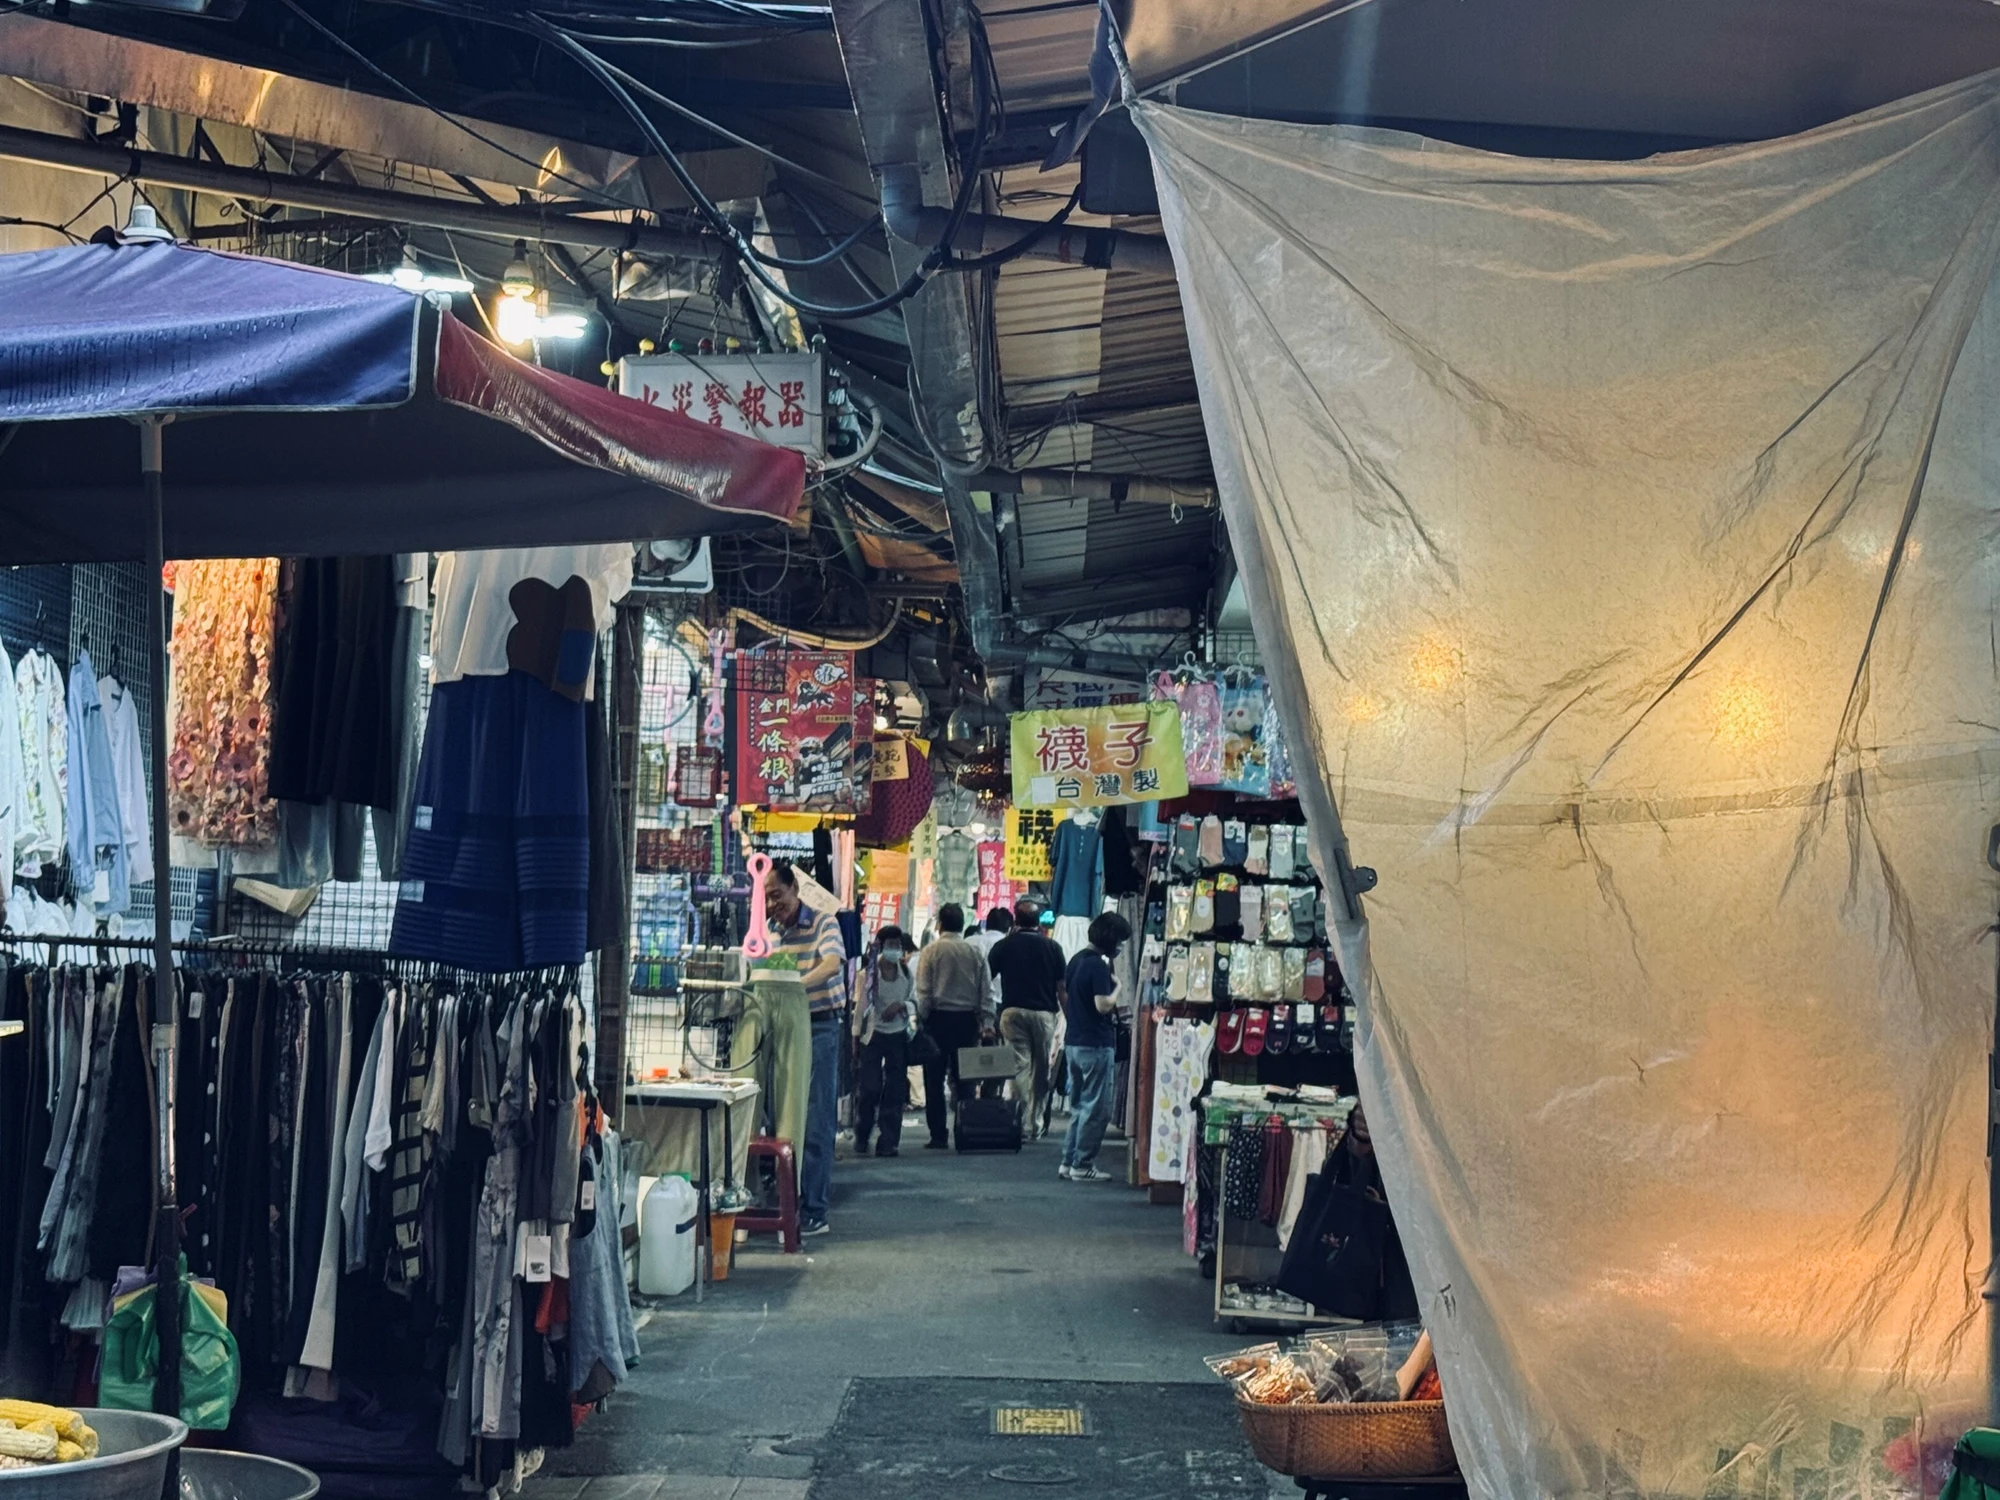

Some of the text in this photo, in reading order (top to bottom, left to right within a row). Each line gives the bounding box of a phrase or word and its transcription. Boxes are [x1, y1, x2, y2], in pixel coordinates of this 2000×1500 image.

[758, 698, 790, 714] 金門
[757, 717, 790, 780] 一條根
[1036, 722, 1153, 772] 襪子
[1056, 768, 1159, 798] 台灣製
